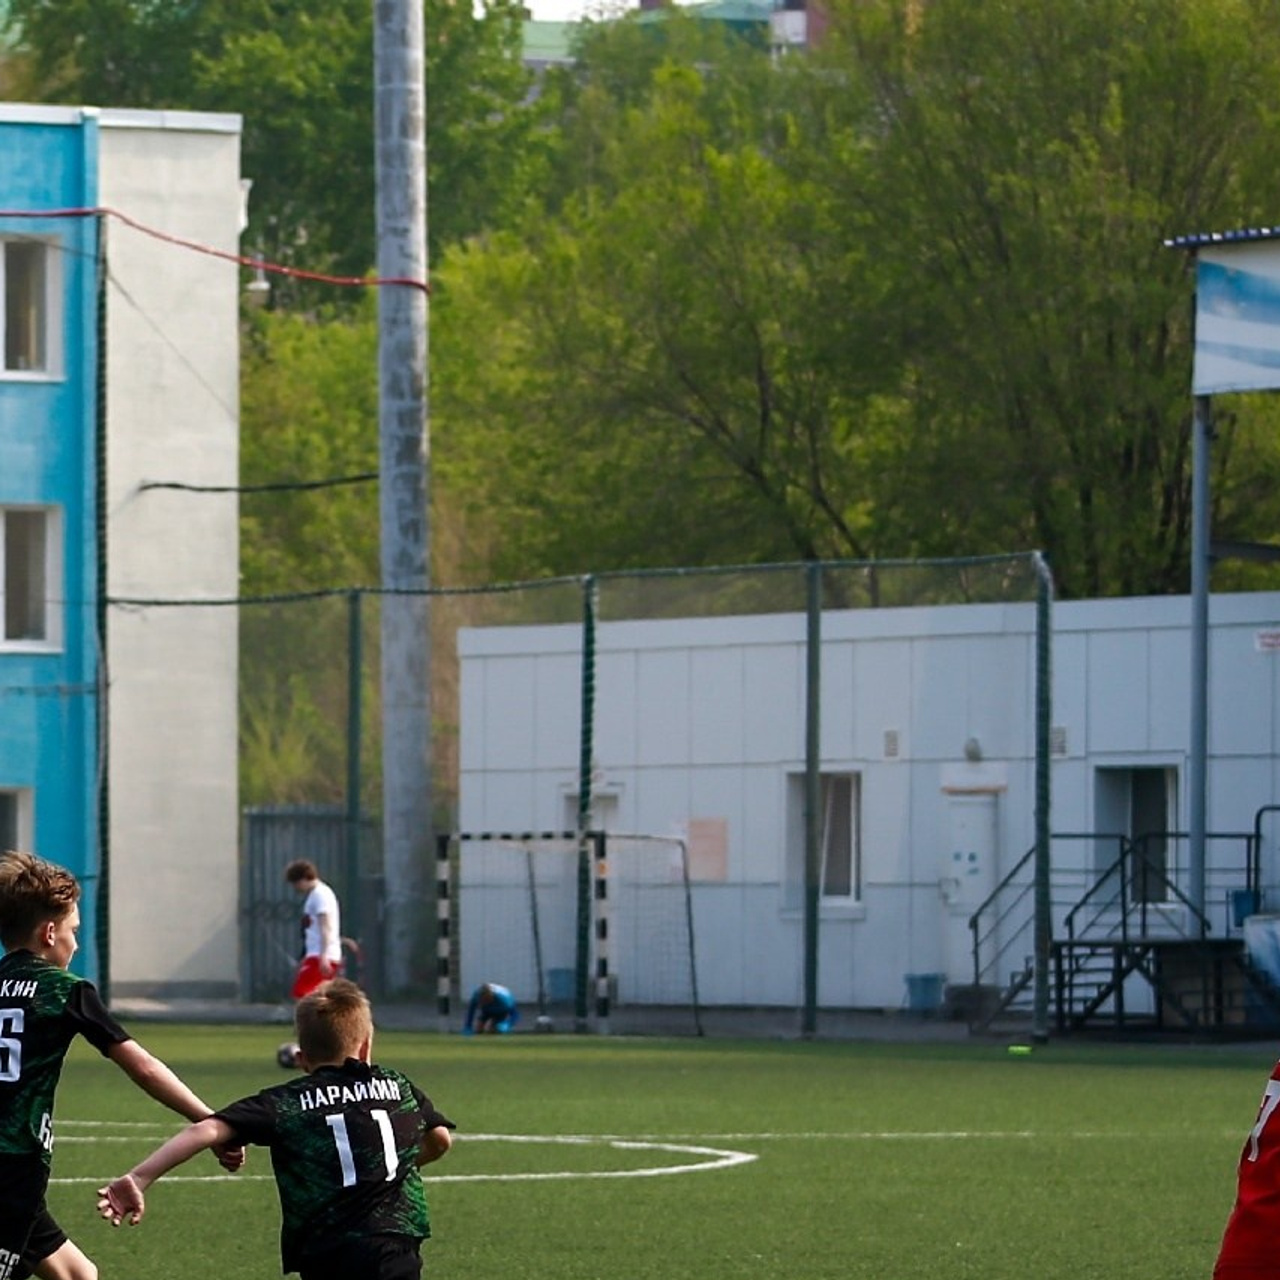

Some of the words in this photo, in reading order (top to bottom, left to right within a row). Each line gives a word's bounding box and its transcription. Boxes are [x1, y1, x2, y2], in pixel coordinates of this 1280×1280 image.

[299, 1077, 401, 1111] НАРАЙКИН
[39, 1113, 54, 1153] 6
[325, 1109, 400, 1188] 11
